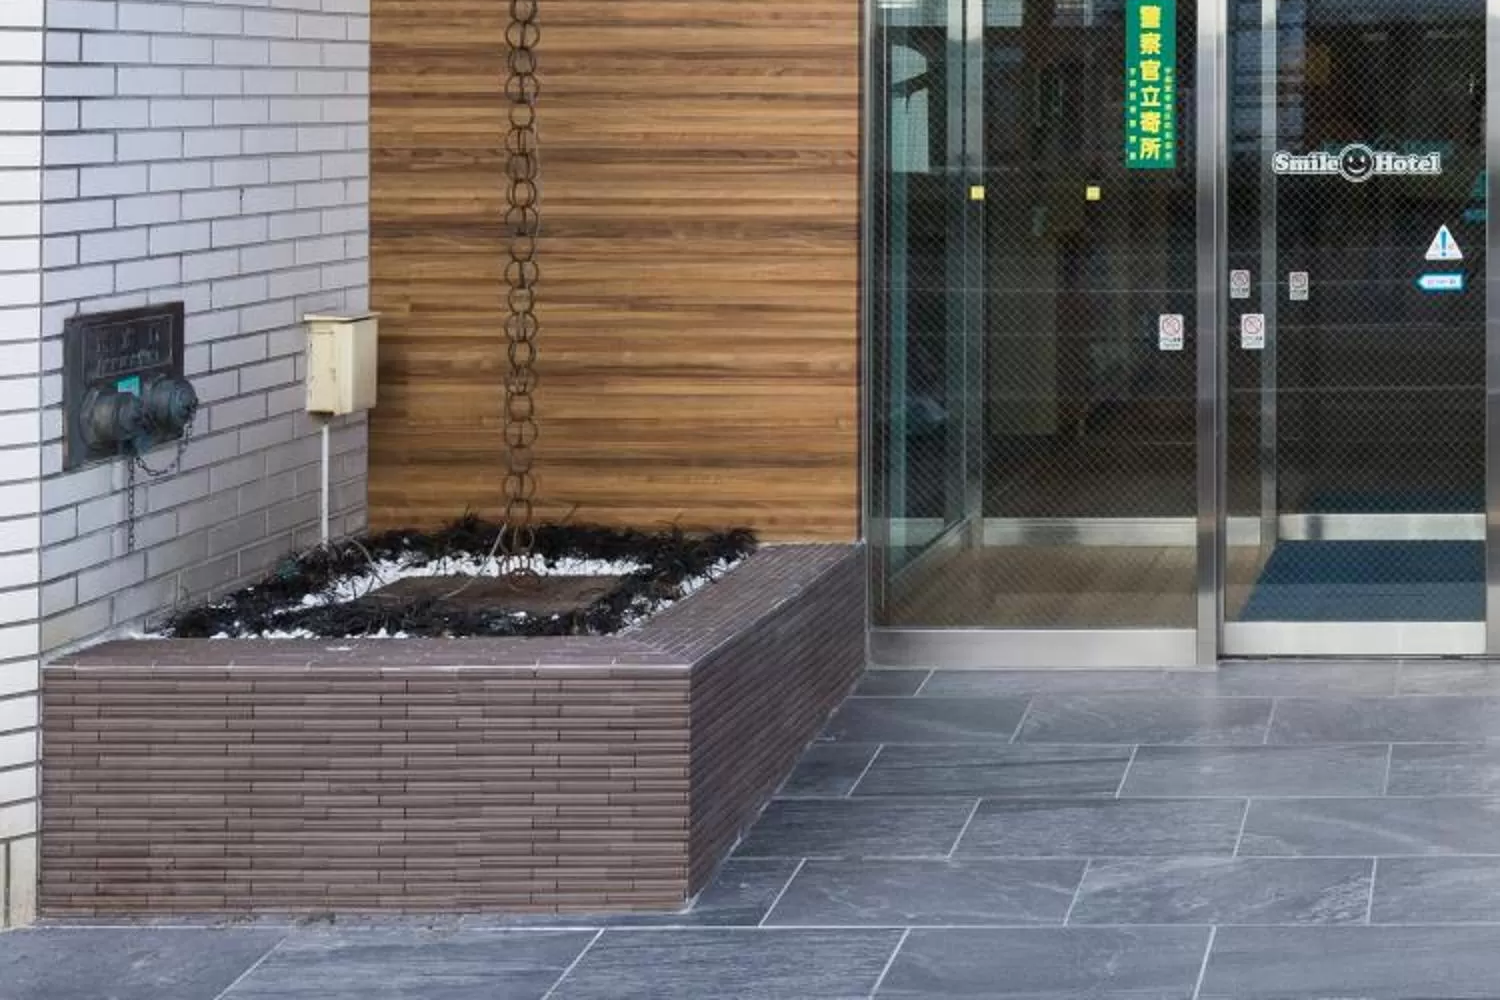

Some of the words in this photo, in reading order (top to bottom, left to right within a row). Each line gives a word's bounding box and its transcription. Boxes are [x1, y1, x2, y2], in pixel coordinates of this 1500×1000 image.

[1139, 5, 1162, 161] 警察官立寄所
[1273, 152, 1339, 172] Smile
[1375, 152, 1440, 172] Hotel
